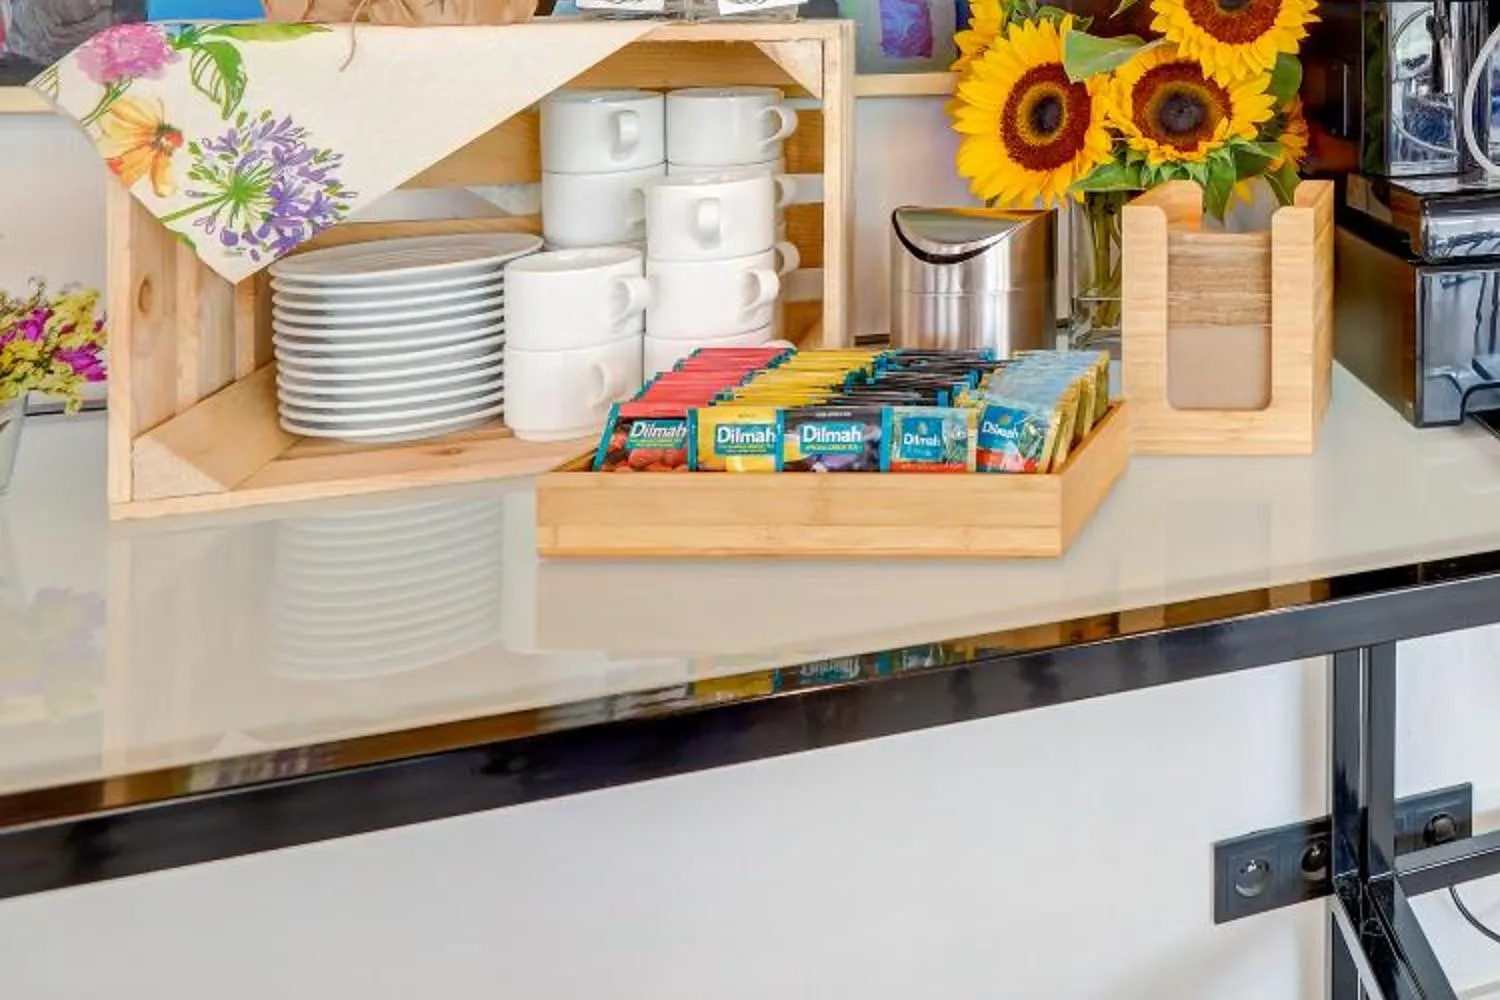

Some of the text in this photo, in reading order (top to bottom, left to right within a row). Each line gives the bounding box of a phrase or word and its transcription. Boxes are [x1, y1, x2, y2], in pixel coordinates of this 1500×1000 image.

[629, 421, 687, 438] Dilmah
[716, 426, 776, 444] Dilmah
[802, 424, 862, 443] Dilmah
